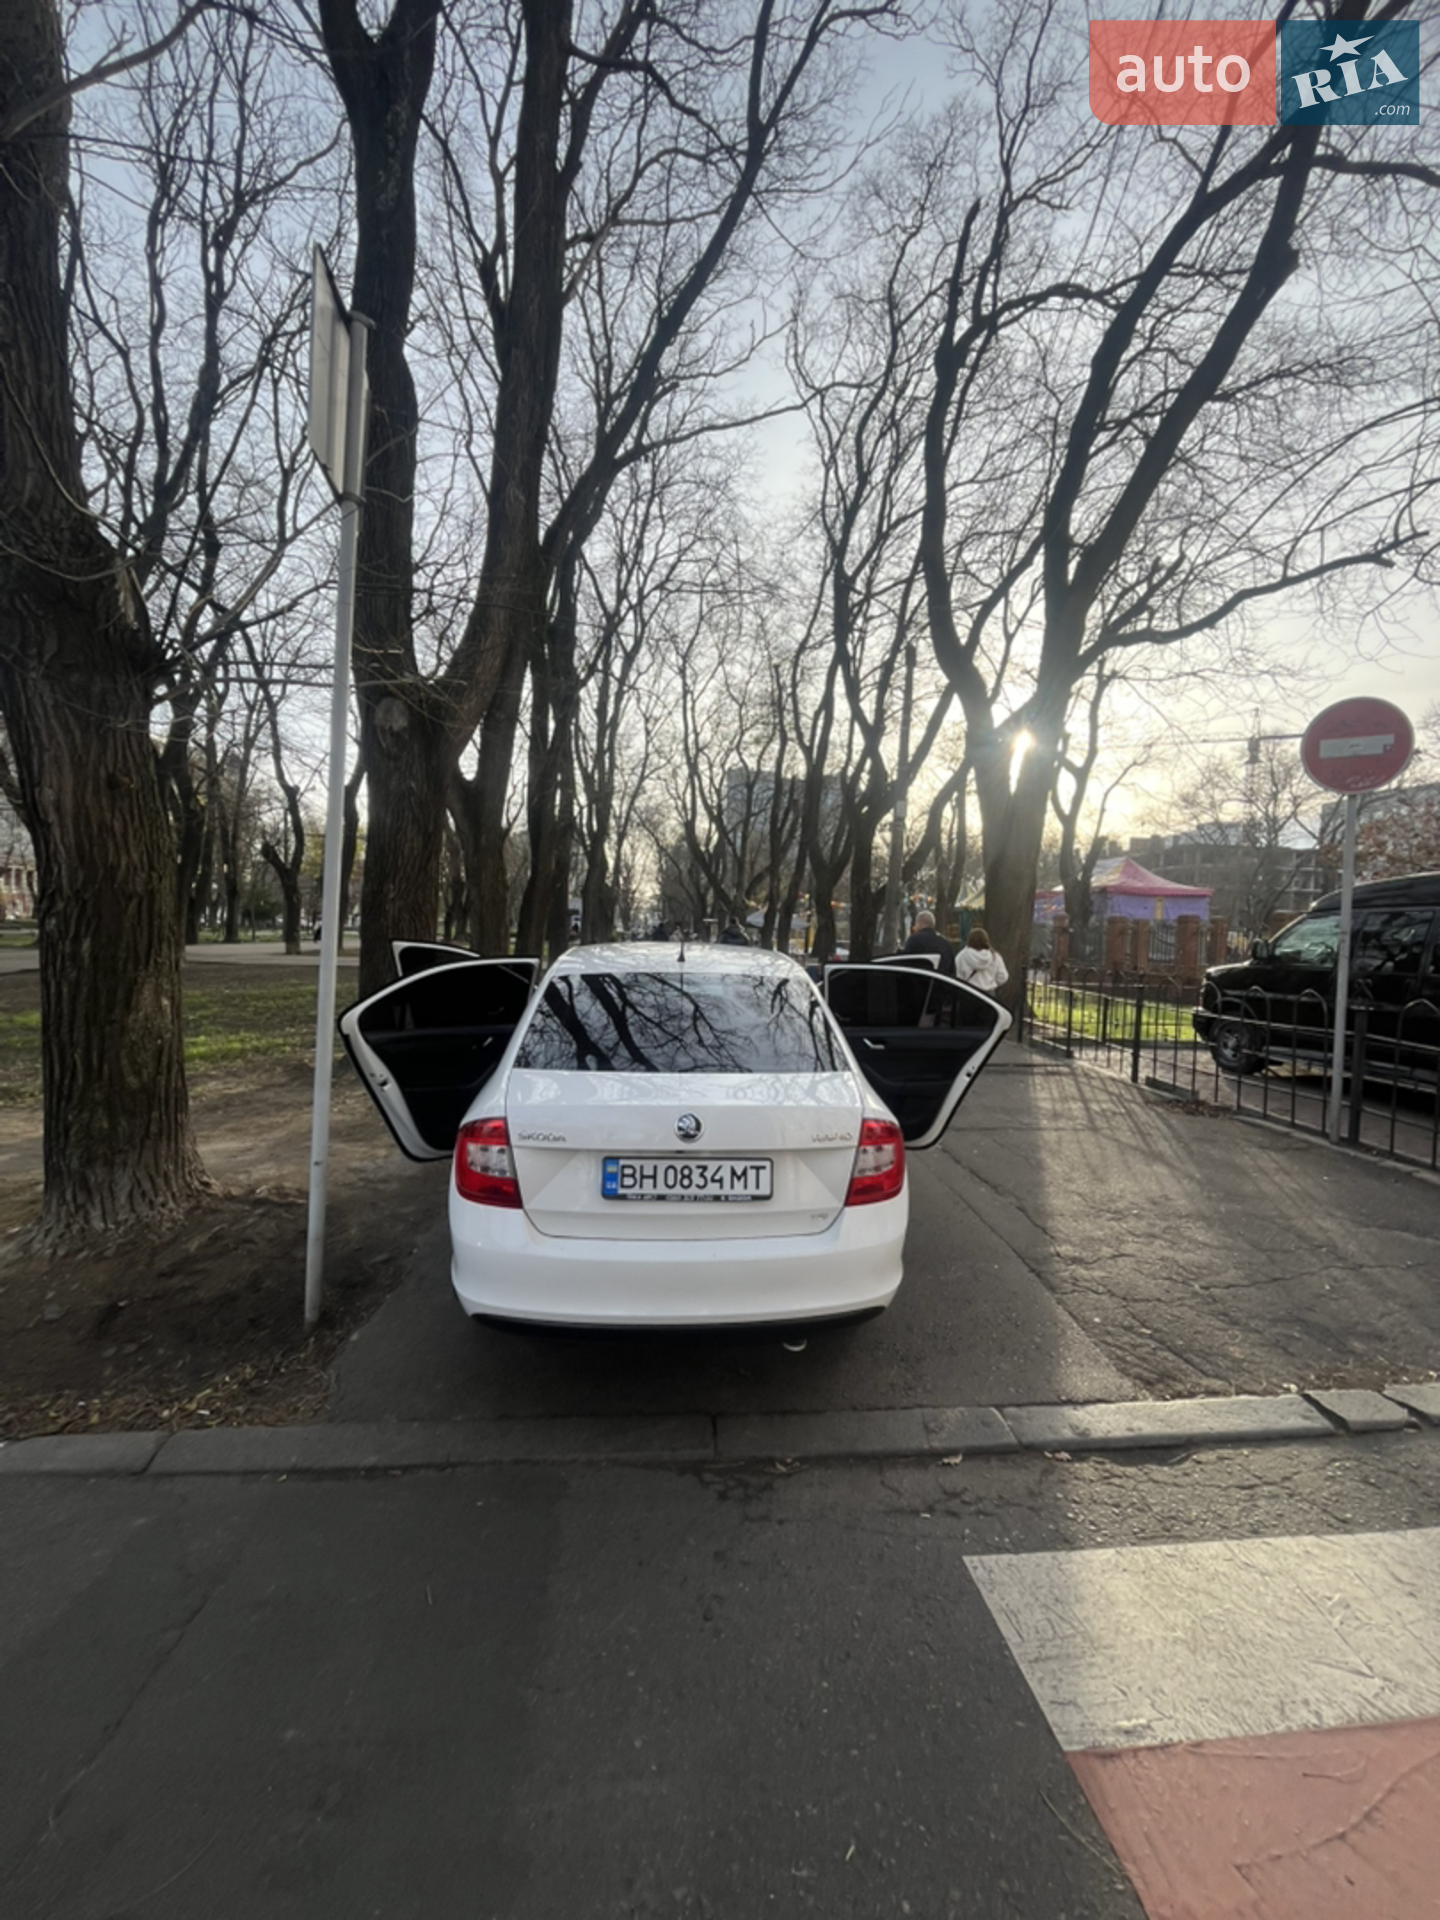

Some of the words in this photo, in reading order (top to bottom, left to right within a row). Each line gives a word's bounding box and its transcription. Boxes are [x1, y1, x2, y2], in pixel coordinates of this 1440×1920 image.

[620, 1164, 657, 1190] BH
[664, 1164, 724, 1190] 0834
[730, 1164, 767, 1190] MT
